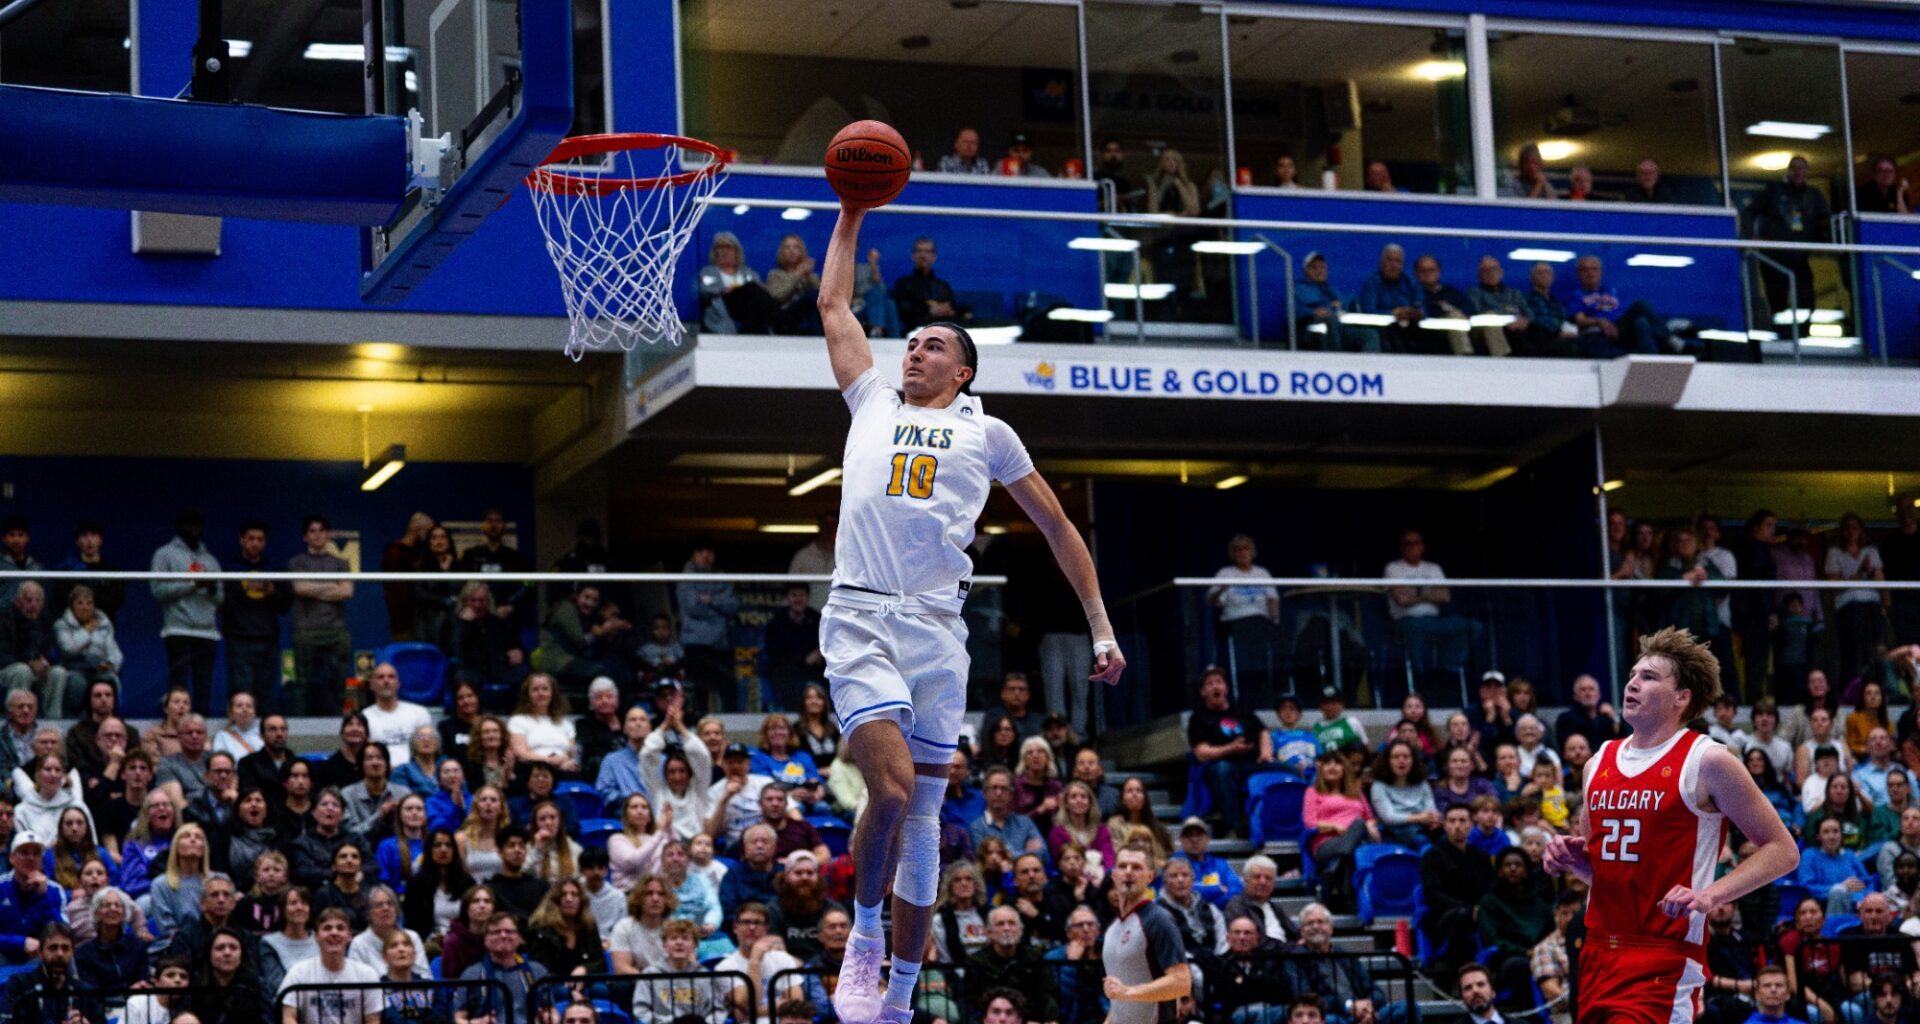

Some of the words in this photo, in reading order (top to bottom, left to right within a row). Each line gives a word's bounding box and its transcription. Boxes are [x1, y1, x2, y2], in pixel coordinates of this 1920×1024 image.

[837, 147, 893, 165] Wilson
[1070, 365, 1152, 391] BLUE
[1162, 369, 1181, 392] &
[1193, 370, 1279, 394] GOLD
[1290, 371, 1383, 396] ROOM
[893, 424, 953, 449] VIKES
[886, 453, 938, 499] 10
[1589, 789, 1666, 811] CALGARY
[1601, 818, 1641, 862] 22
[786, 926, 818, 939] RVC
